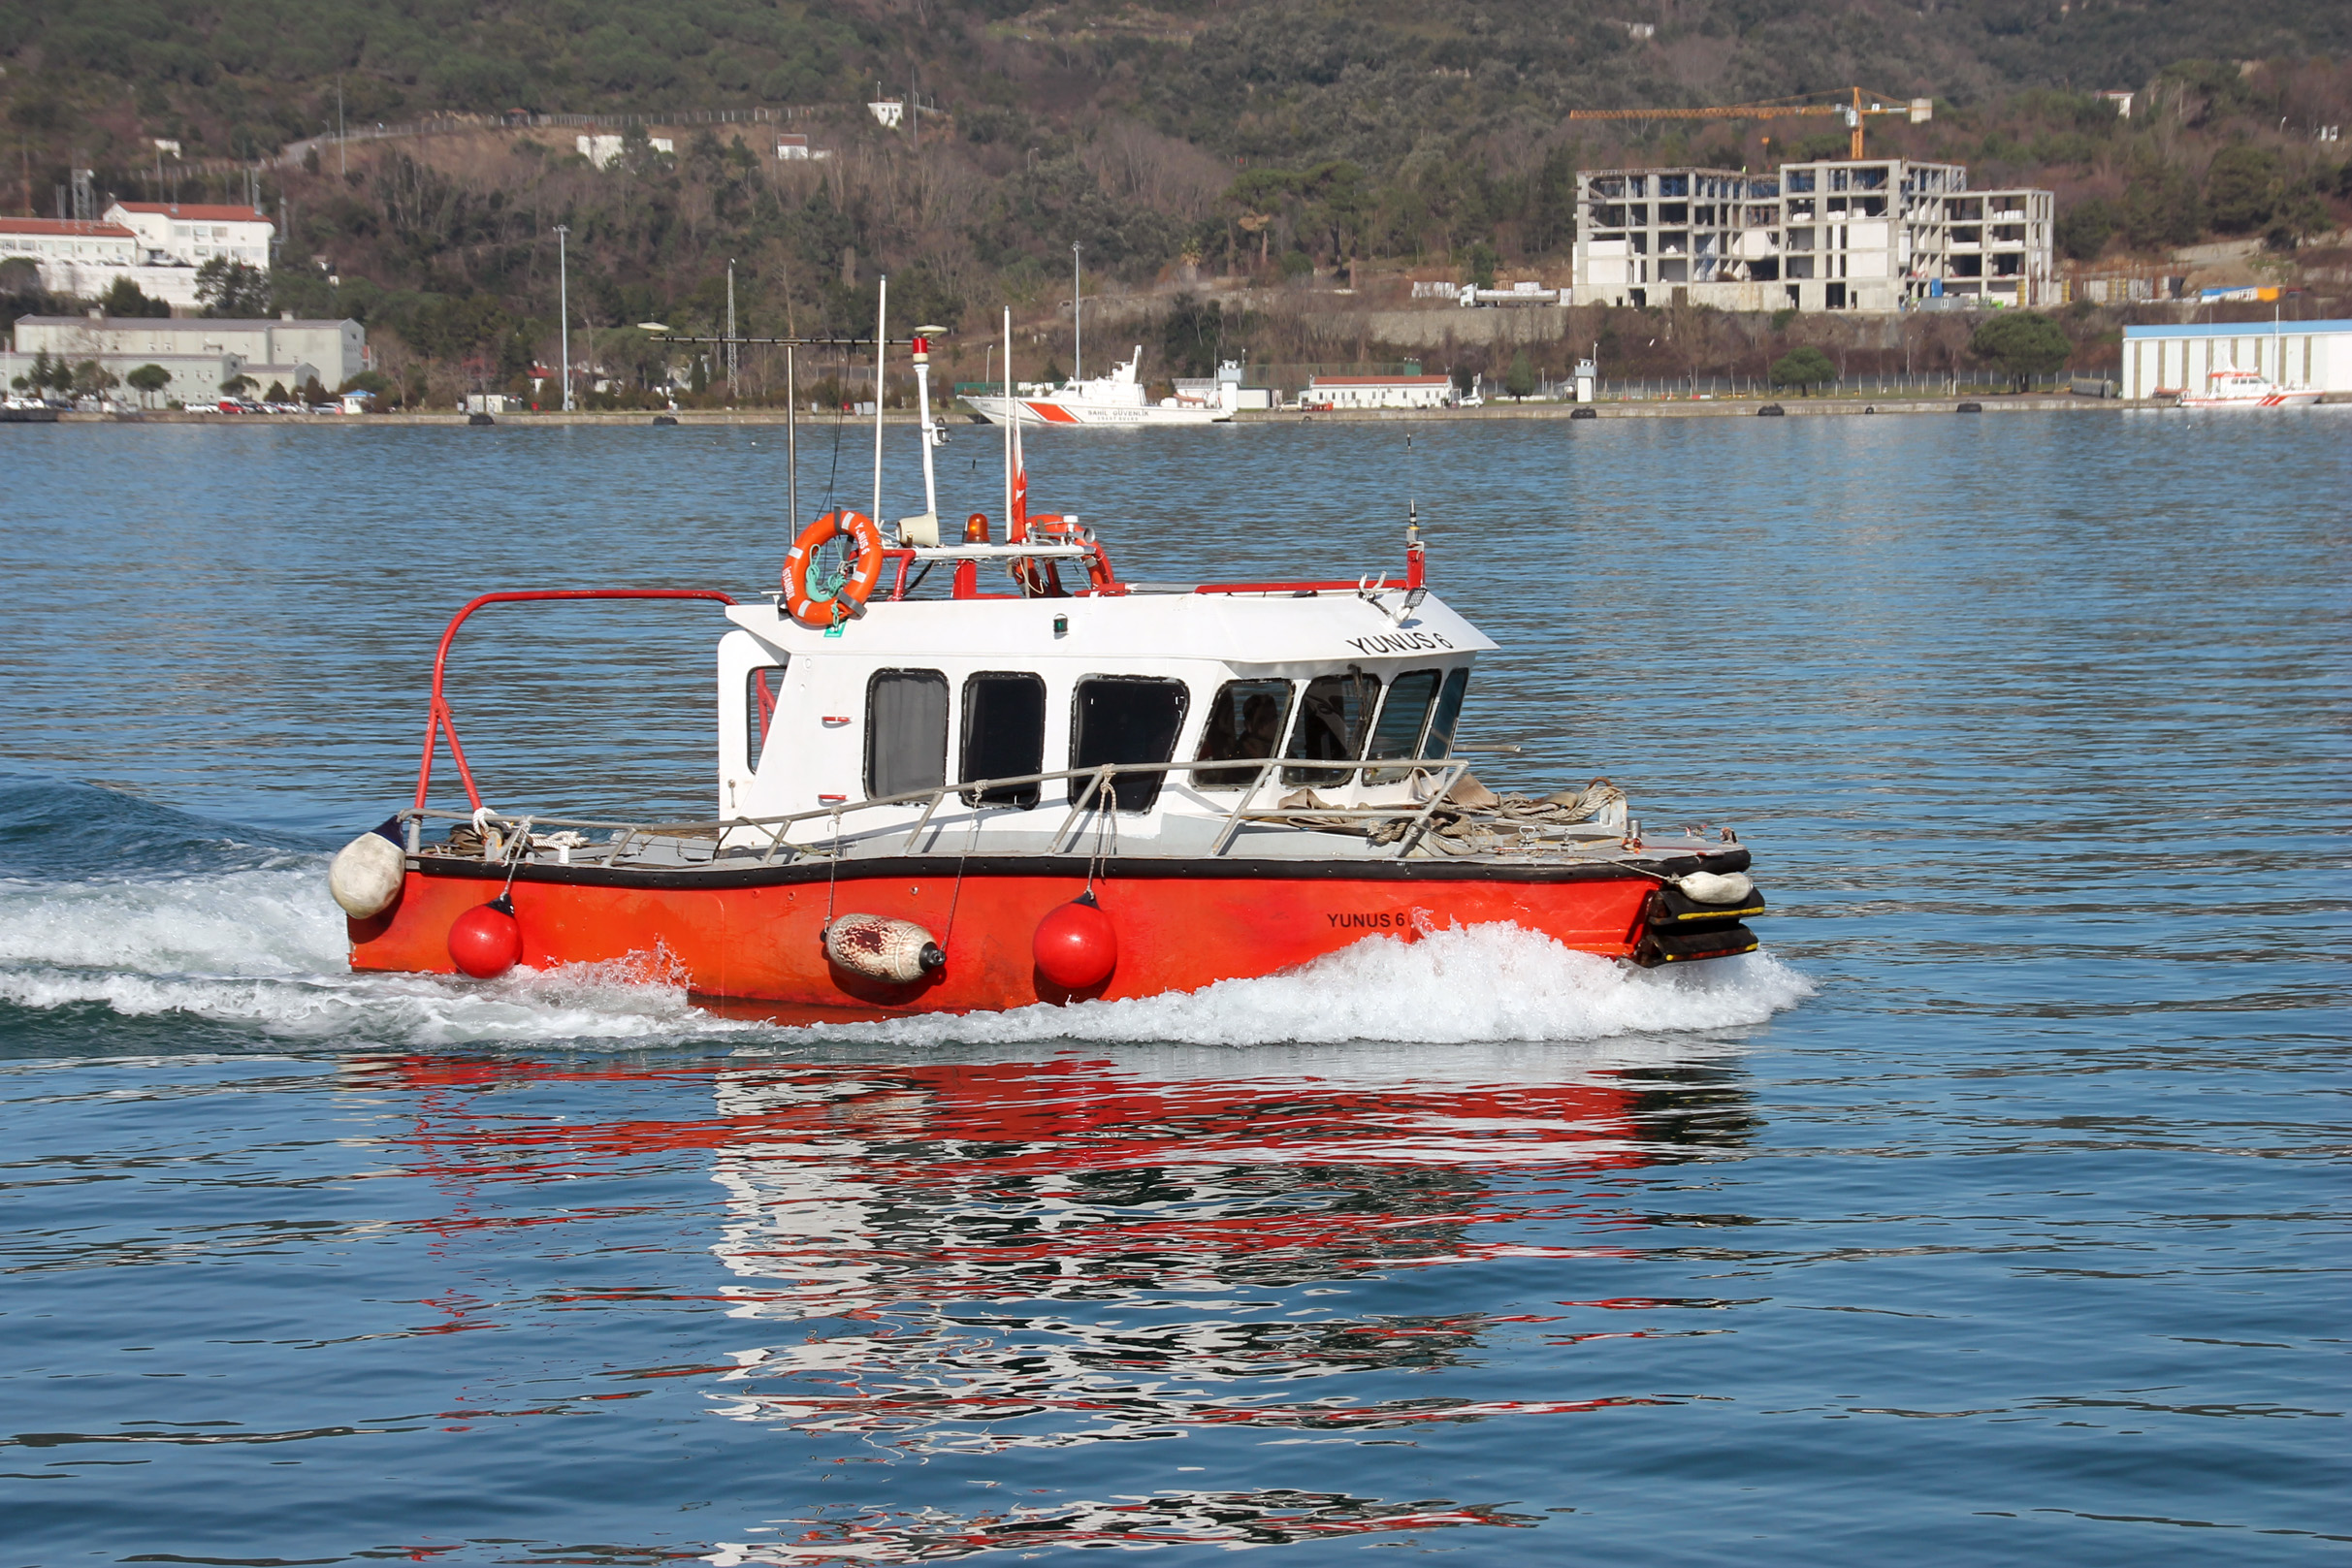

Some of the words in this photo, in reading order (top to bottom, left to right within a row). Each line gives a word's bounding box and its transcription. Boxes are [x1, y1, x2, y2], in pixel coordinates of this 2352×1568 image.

[1345, 632, 1436, 656] YUNUS
[1434, 633, 1454, 649] 6
[1327, 913, 1391, 928] YUNUS
[1396, 912, 1405, 926] 6
